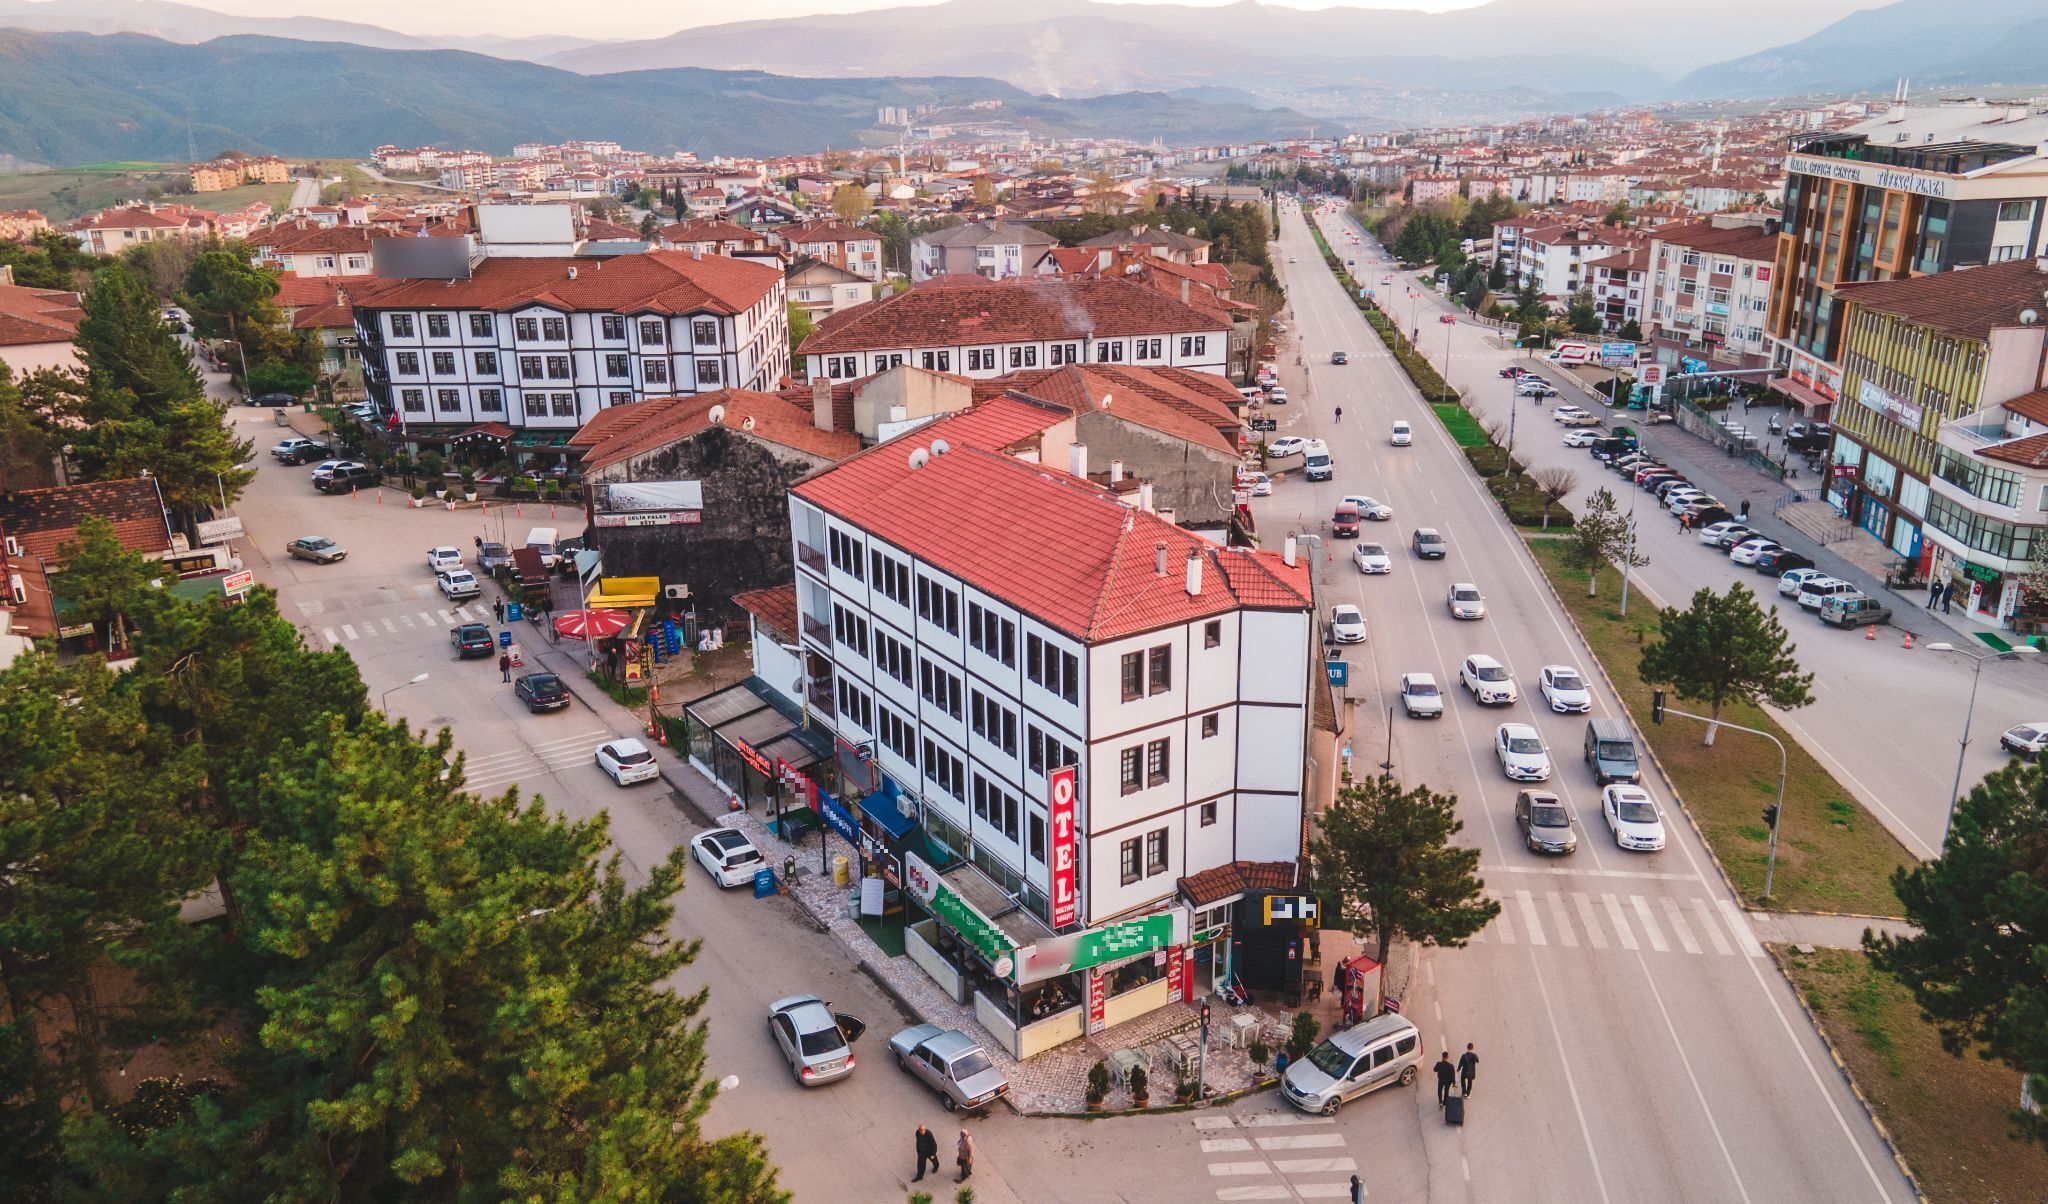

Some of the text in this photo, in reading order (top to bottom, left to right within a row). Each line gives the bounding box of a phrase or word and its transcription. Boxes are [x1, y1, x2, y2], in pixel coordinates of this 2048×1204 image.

[1809, 161, 1831, 177] OFFICE
[1833, 165, 1860, 182] CENTER
[1914, 176, 1945, 197] PLAZA
[1328, 669, 1342, 678] UB
[1055, 777, 1072, 904] OTEL
